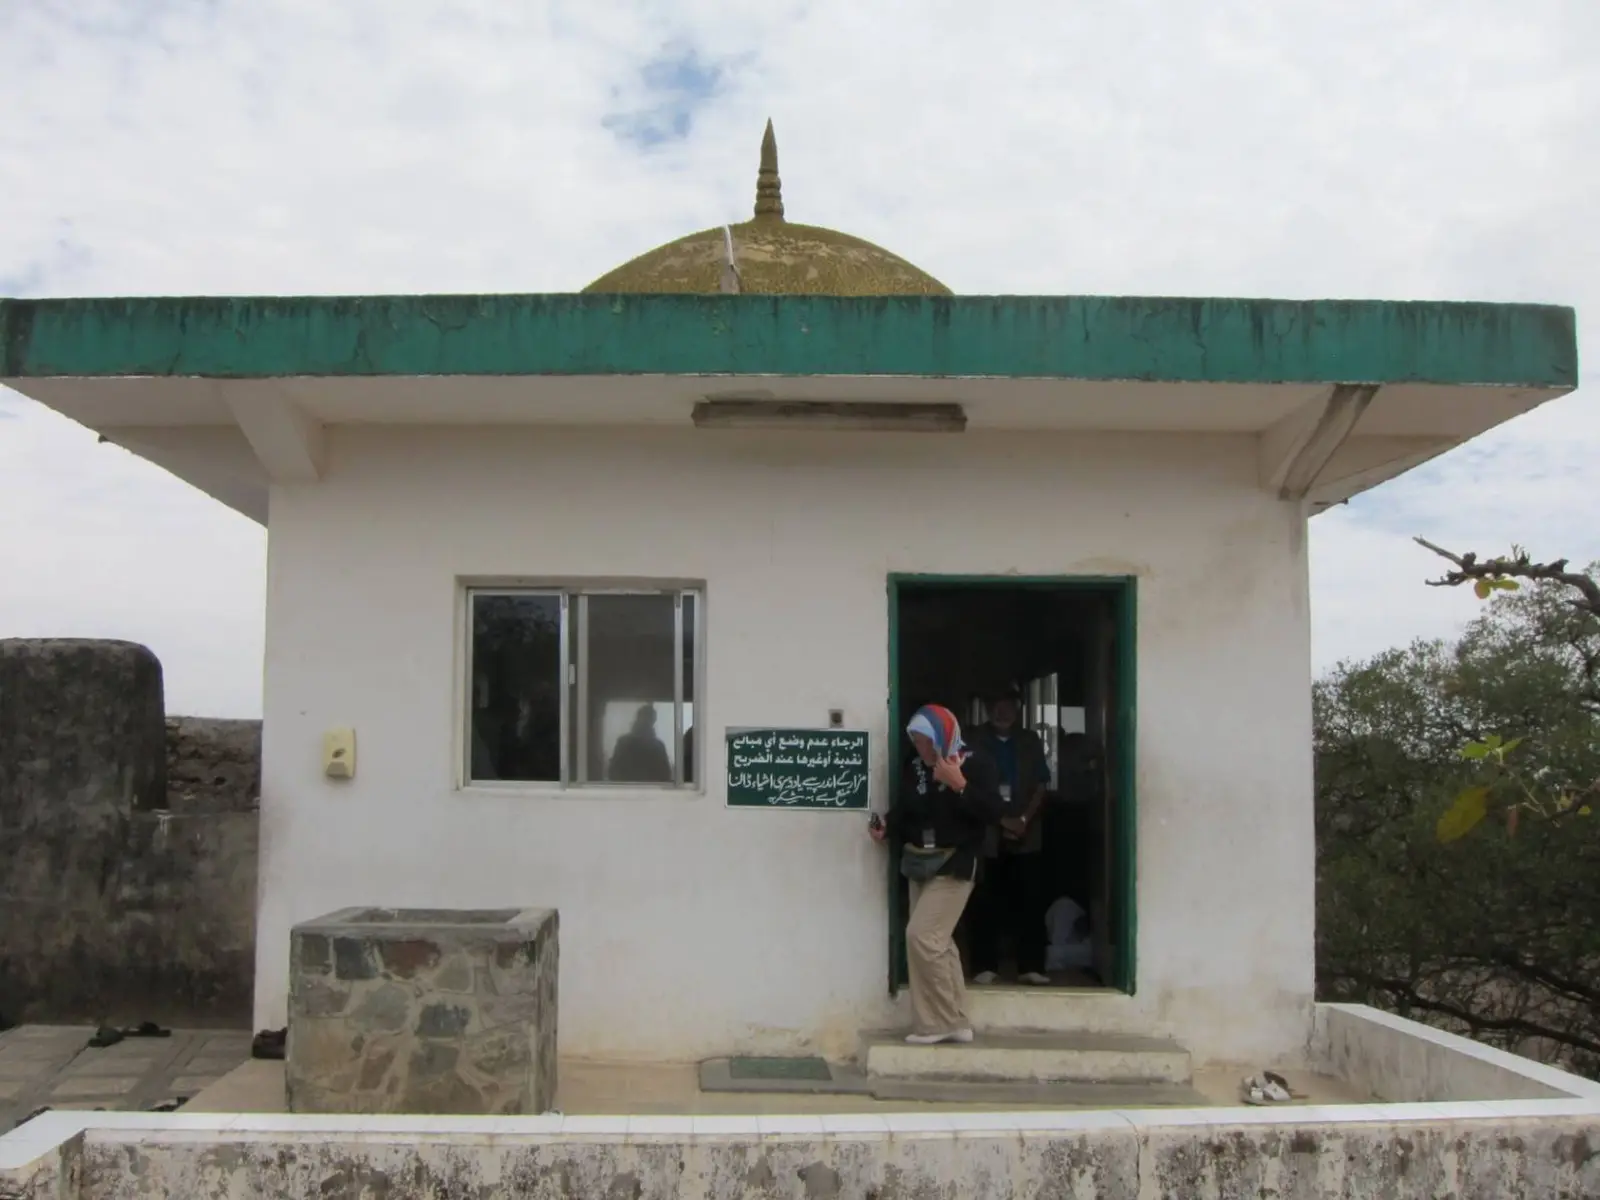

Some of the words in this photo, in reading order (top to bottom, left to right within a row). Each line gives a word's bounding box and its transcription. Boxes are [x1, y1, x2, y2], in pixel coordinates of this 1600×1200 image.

[764, 732, 776, 752] أي
[778, 735, 805, 750] وضع
[807, 737, 829, 750] عدم
[831, 736, 864, 750] الرجاء
[733, 753, 773, 767] الضريح
[775, 754, 794, 764] عند
[833, 752, 862, 768] نقدية
